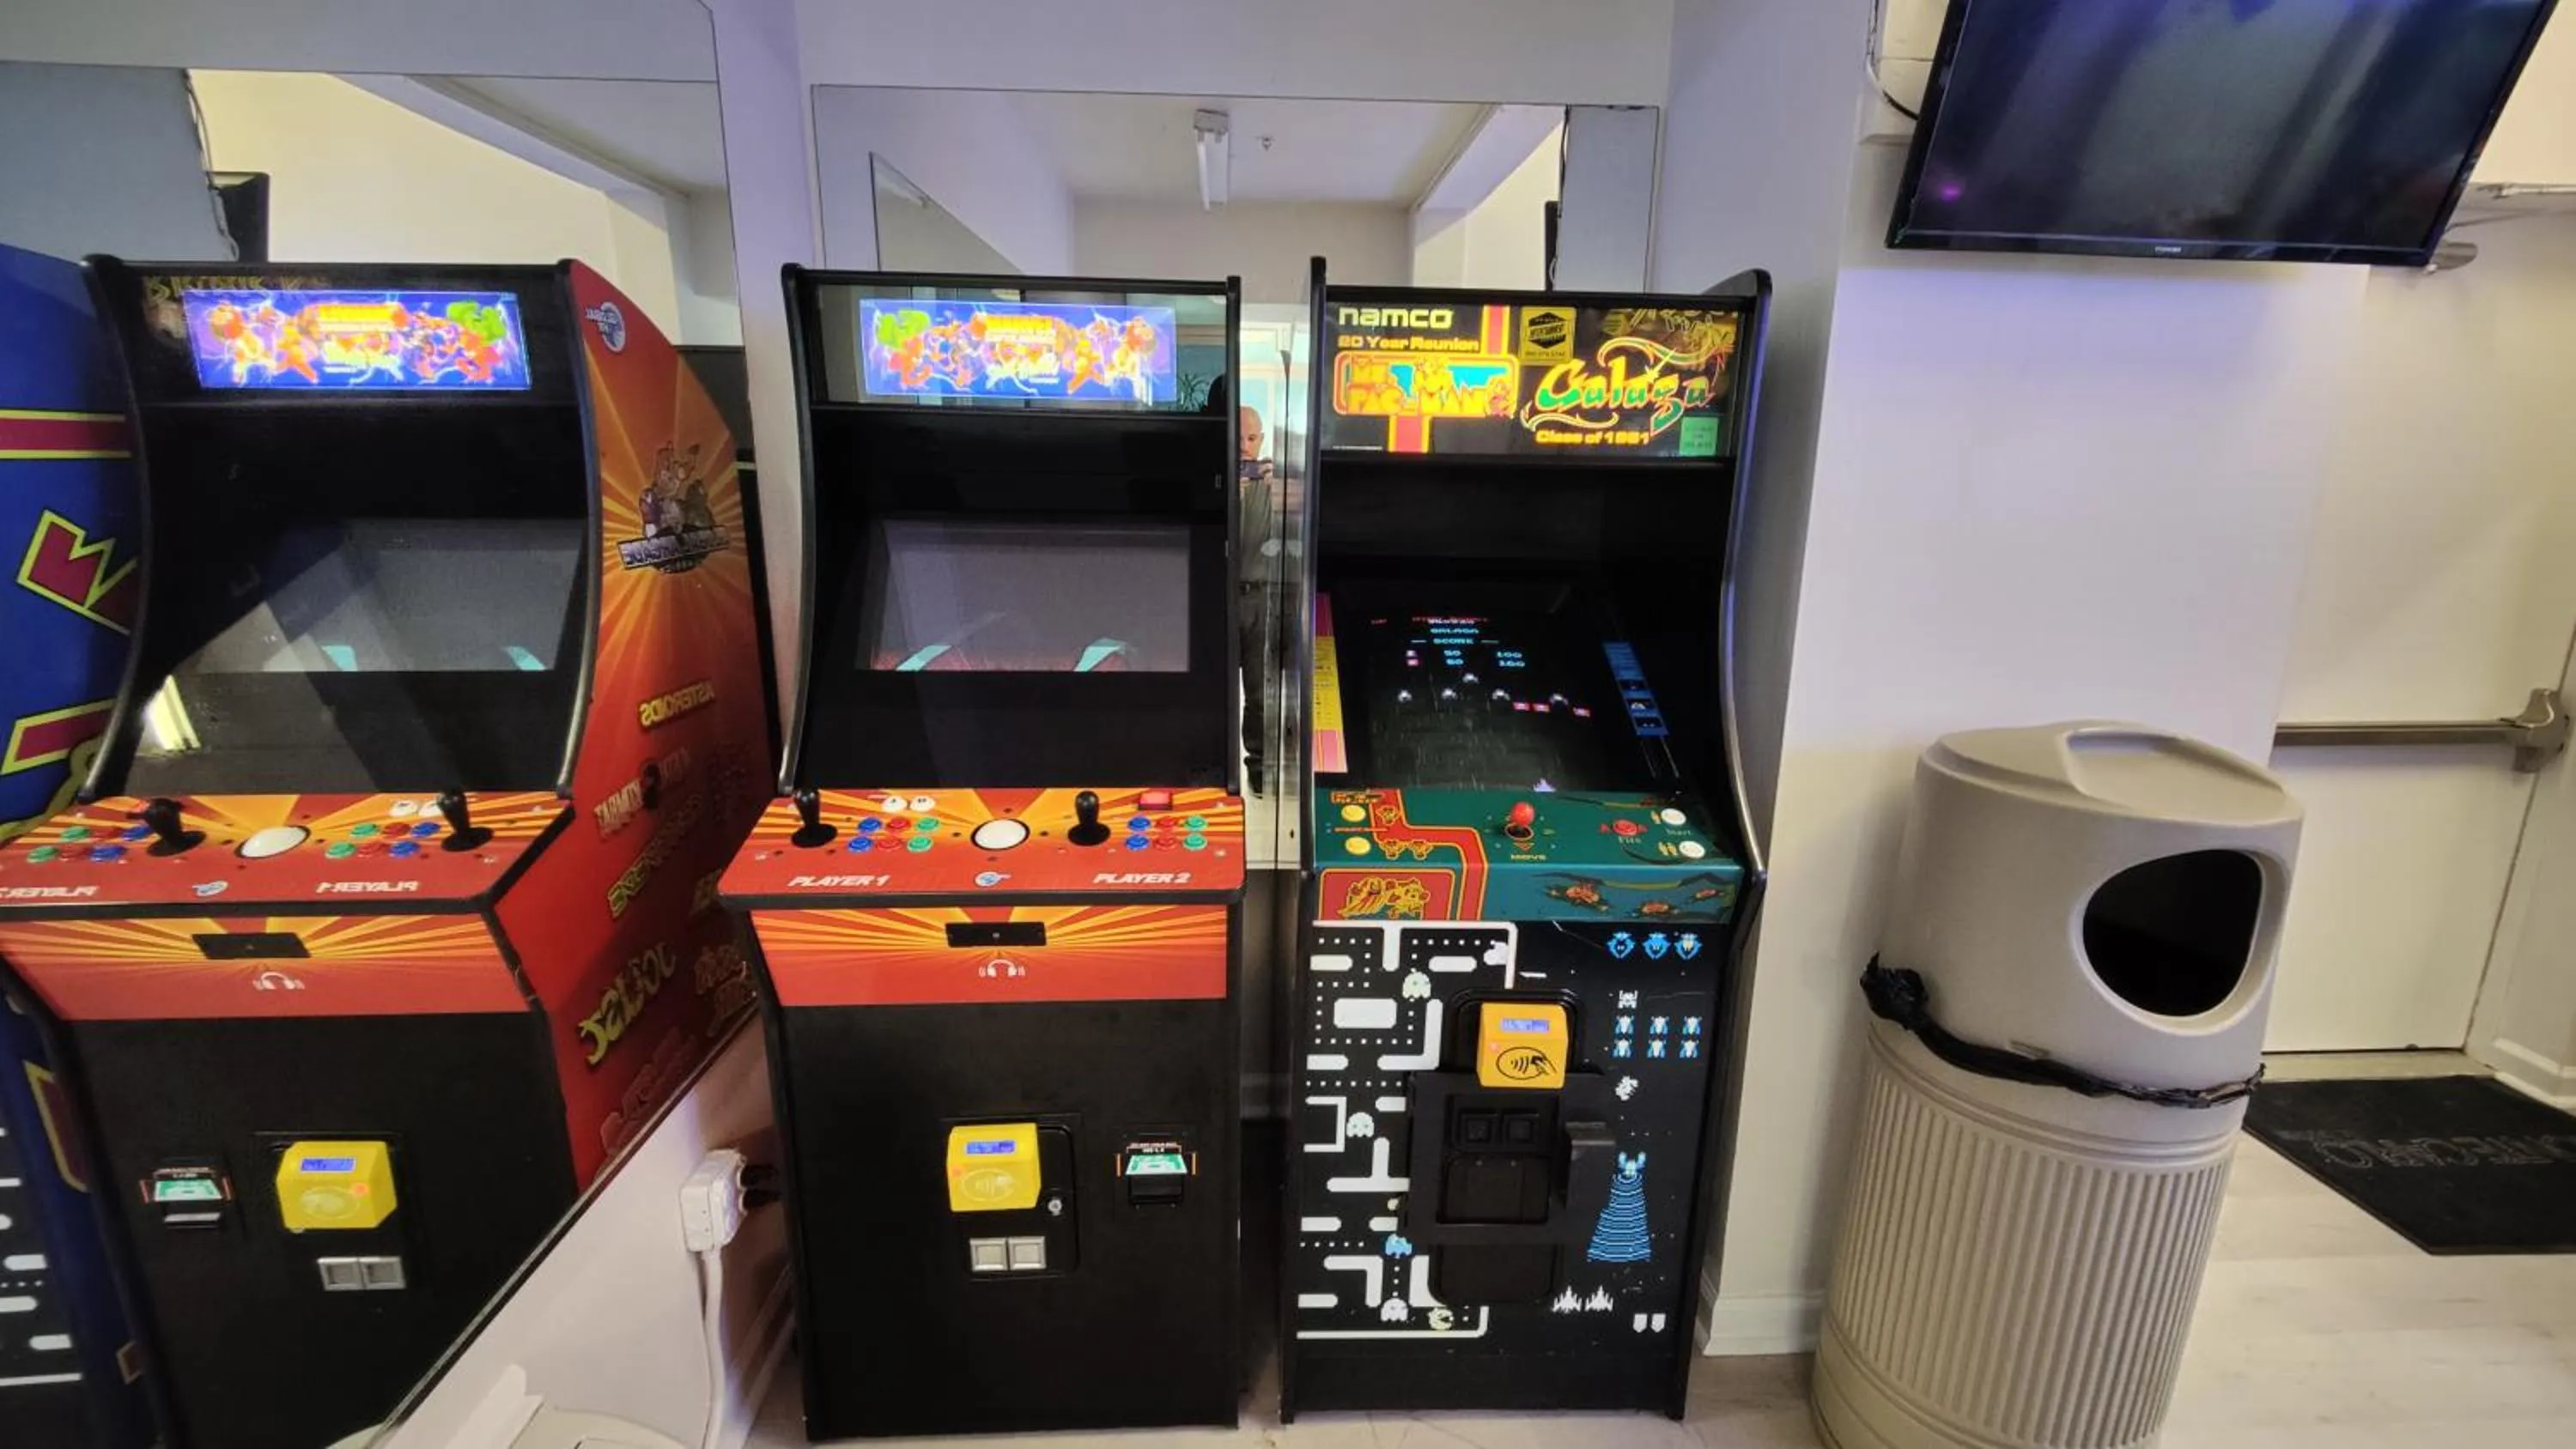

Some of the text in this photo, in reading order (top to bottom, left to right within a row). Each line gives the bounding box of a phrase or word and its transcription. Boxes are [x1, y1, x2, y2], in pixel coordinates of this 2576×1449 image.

[1339, 307, 1454, 329] namco
[1366, 336, 1408, 350] Year
[1410, 336, 1479, 351] Reunion
[1535, 429, 1649, 445] Class of 1981
[787, 875, 890, 887] PLAYER 1
[1093, 872, 1191, 884] PLAYER 2
